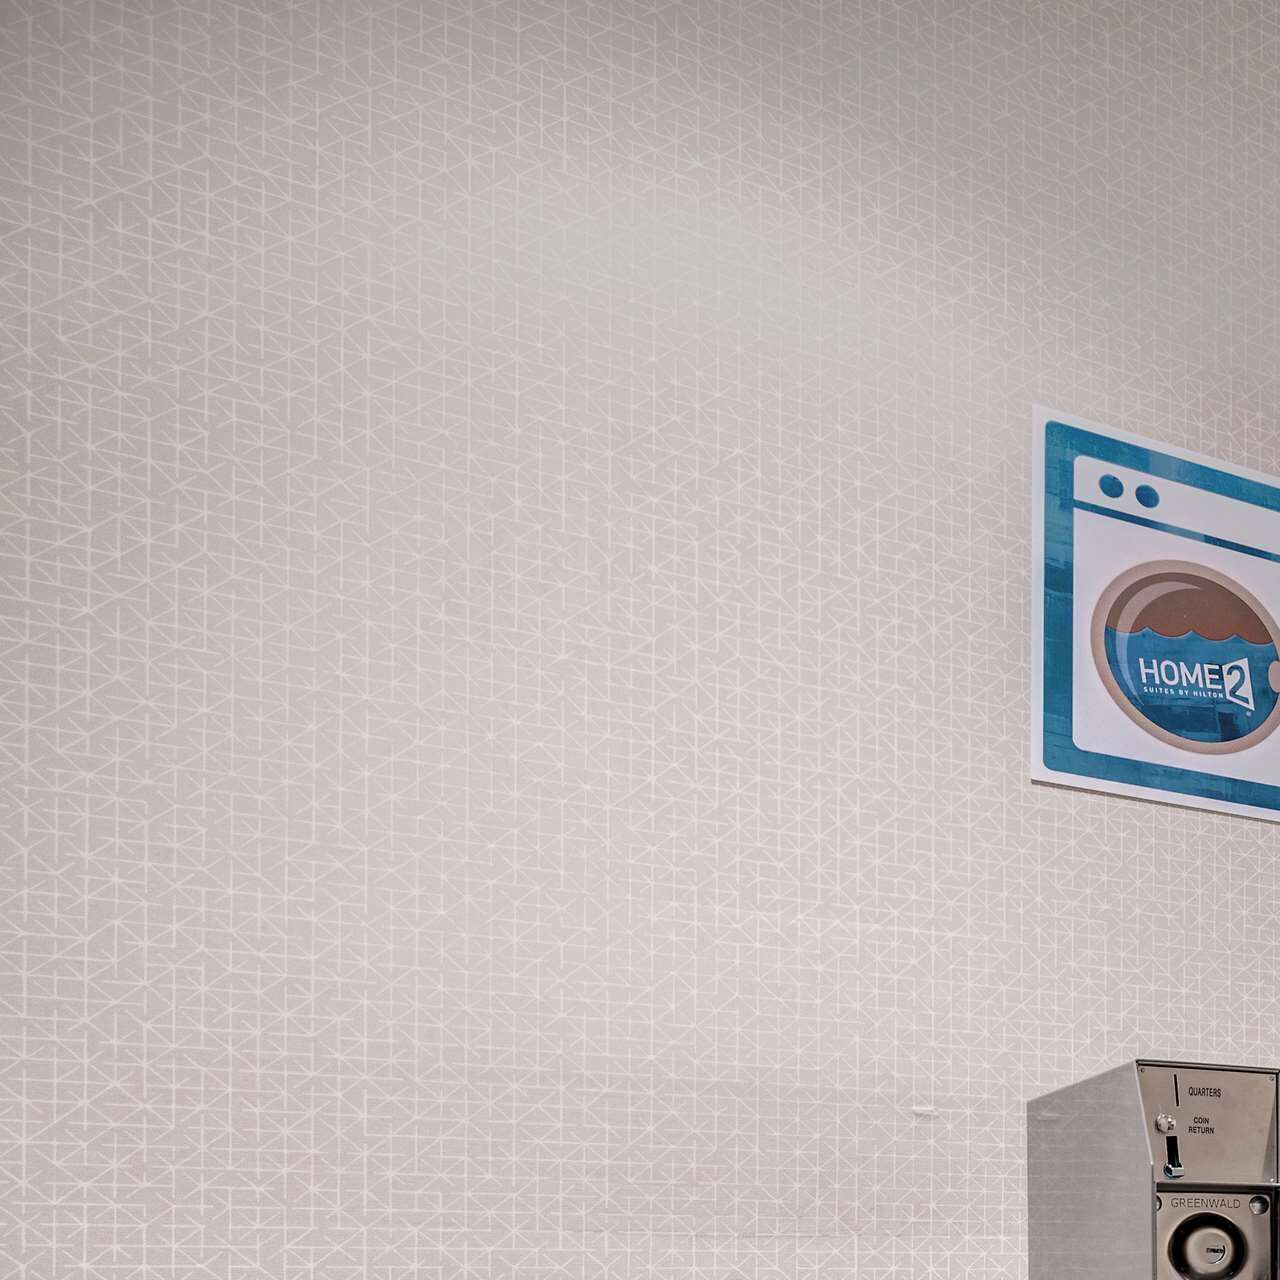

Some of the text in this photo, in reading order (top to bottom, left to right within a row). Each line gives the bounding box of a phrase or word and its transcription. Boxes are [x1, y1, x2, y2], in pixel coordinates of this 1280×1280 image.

[1138, 656, 1255, 712] HOME2
[1143, 686, 1175, 695] SUITES
[1193, 690, 1224, 699] HILTON
[1188, 1086, 1222, 1098] QUARTERS
[1193, 1117, 1210, 1125] COIN
[1188, 1126, 1215, 1134] RETURN
[1170, 1198, 1240, 1209] GREENWALD
